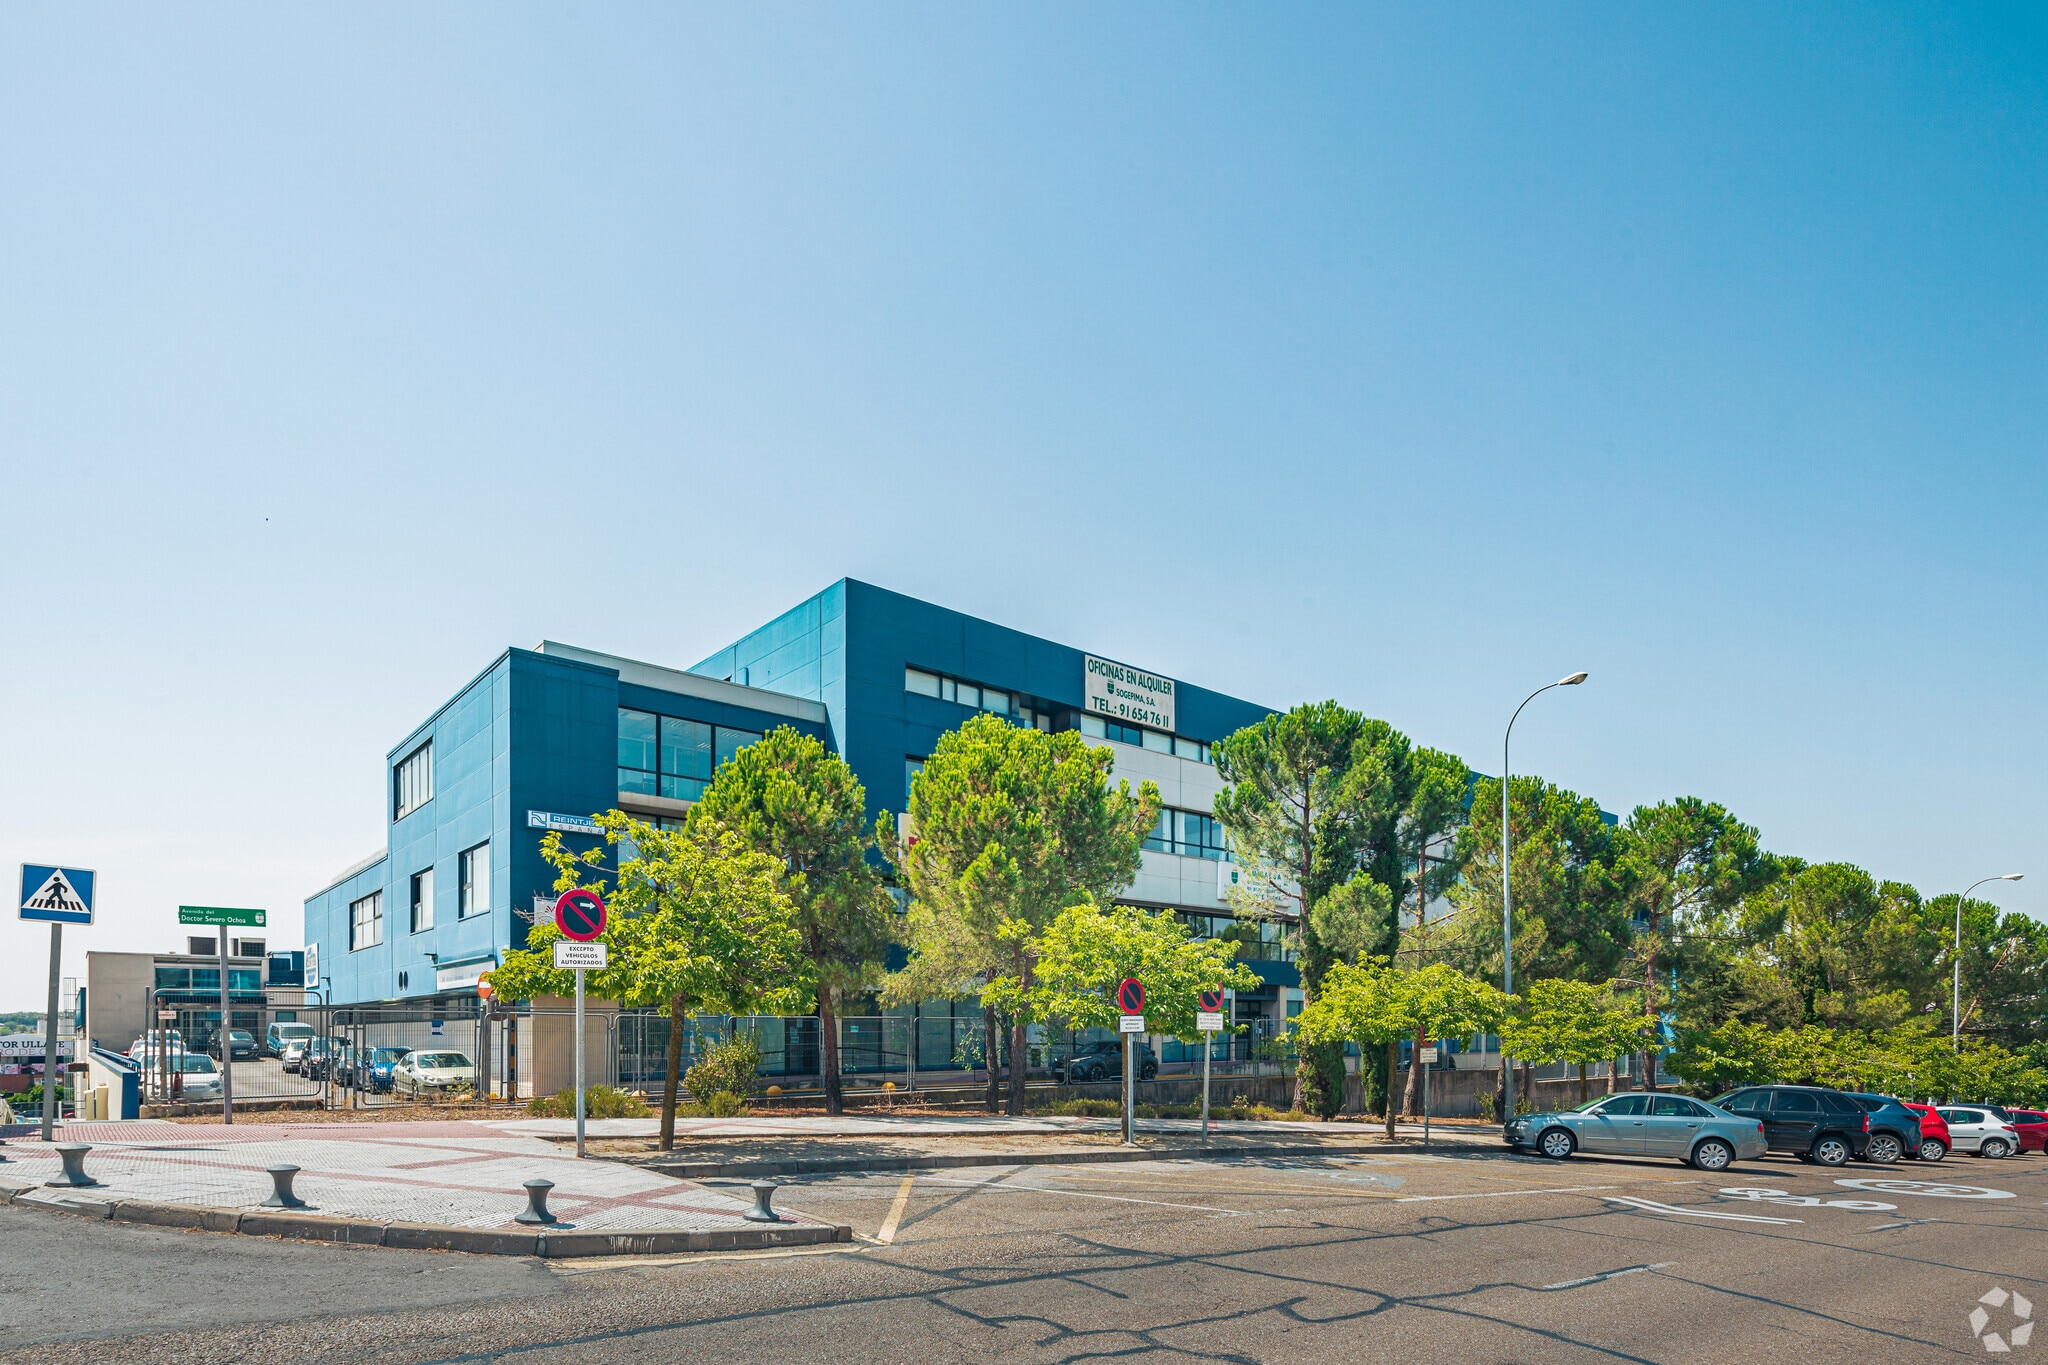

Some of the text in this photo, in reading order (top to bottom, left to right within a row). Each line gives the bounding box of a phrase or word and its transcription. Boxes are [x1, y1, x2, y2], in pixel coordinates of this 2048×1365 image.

[1087, 658, 1172, 696] OFICINAS EN ALQUILER
[1116, 688, 1156, 707] SOGEPIMA, S.A.
[1092, 695, 1117, 715] TEL.:
[1119, 703, 1130, 718] 91
[1131, 707, 1148, 723] 654
[1150, 711, 1161, 726] 76
[553, 815, 597, 827] REINTJE
[181, 914, 247, 924] Doctor Severo Ochoa
